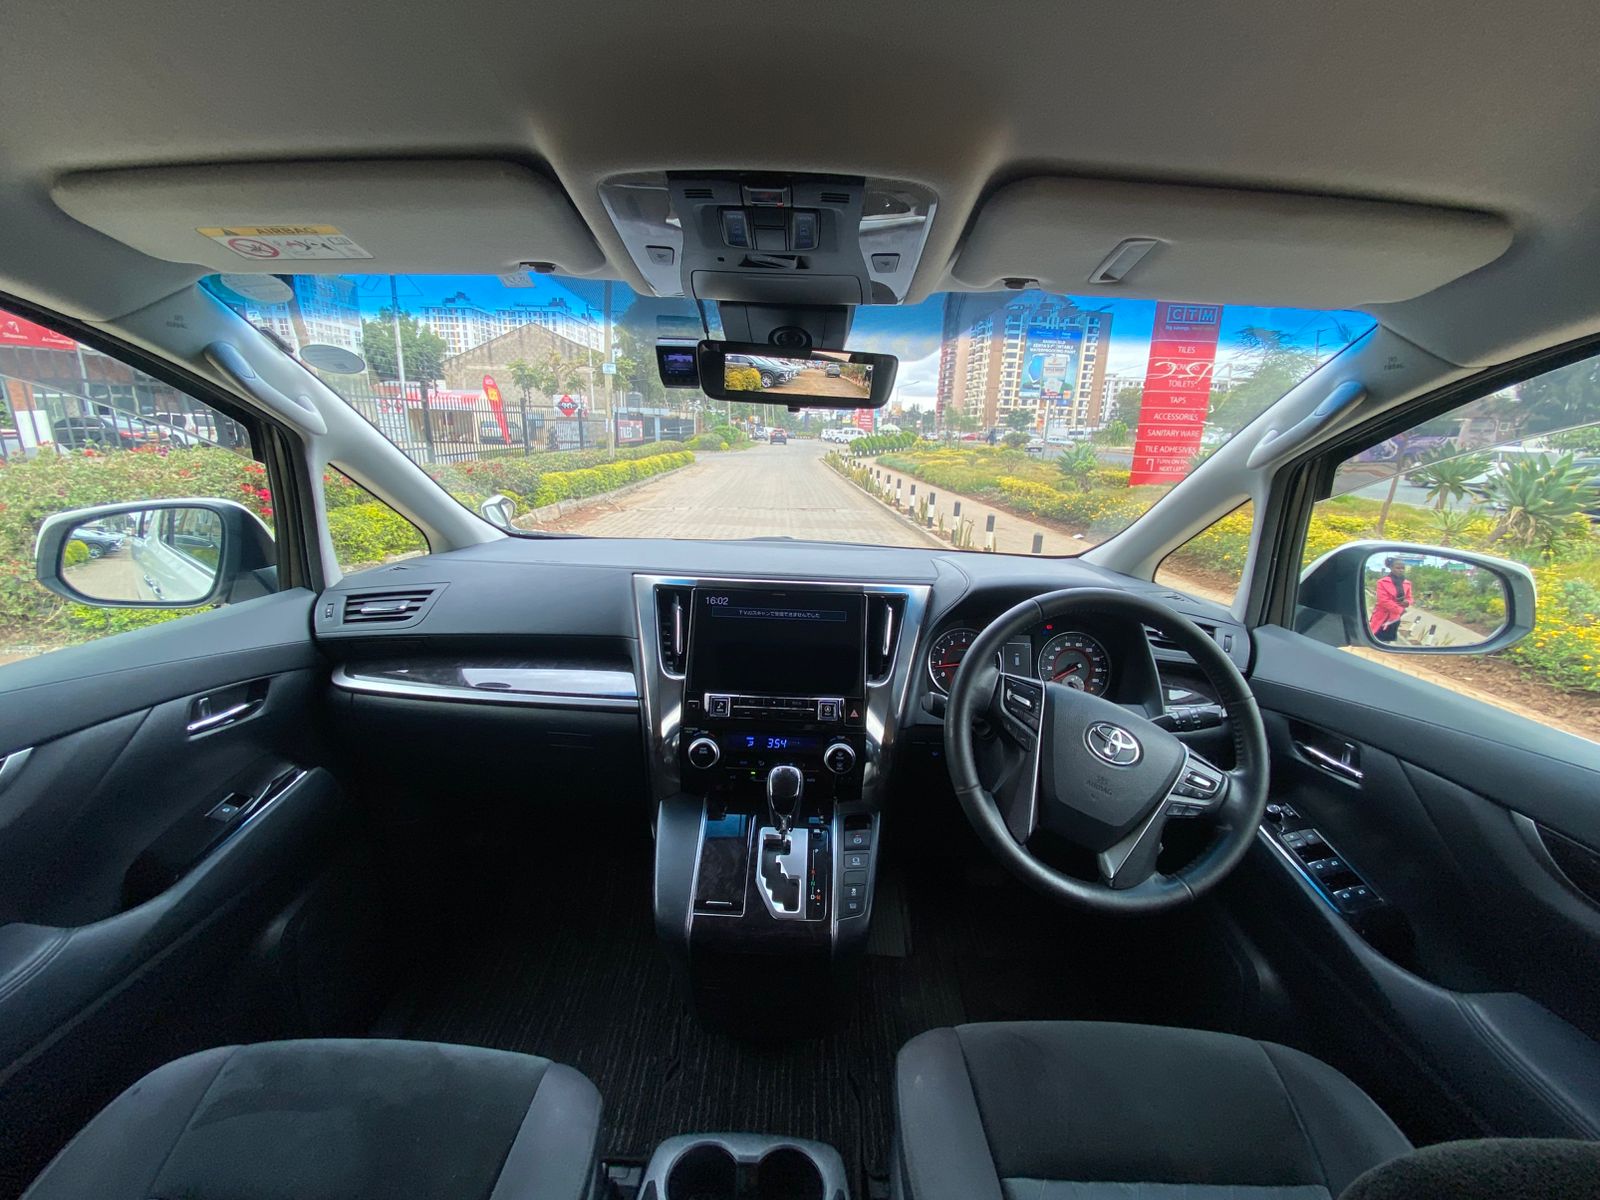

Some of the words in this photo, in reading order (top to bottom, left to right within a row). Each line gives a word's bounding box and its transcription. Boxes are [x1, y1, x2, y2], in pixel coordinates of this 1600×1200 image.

[255, 227, 317, 235] AIRBAG
[1171, 307, 1214, 321] CTM
[1177, 346, 1196, 354] TILES
[1168, 380, 1196, 388] TOILETS
[1170, 396, 1186, 404] TAPS
[1153, 412, 1199, 421] ACCESSORIES
[1147, 429, 1179, 437] SANITARY
[1145, 445, 1159, 453] TILE
[705, 597, 729, 606] 16:02
